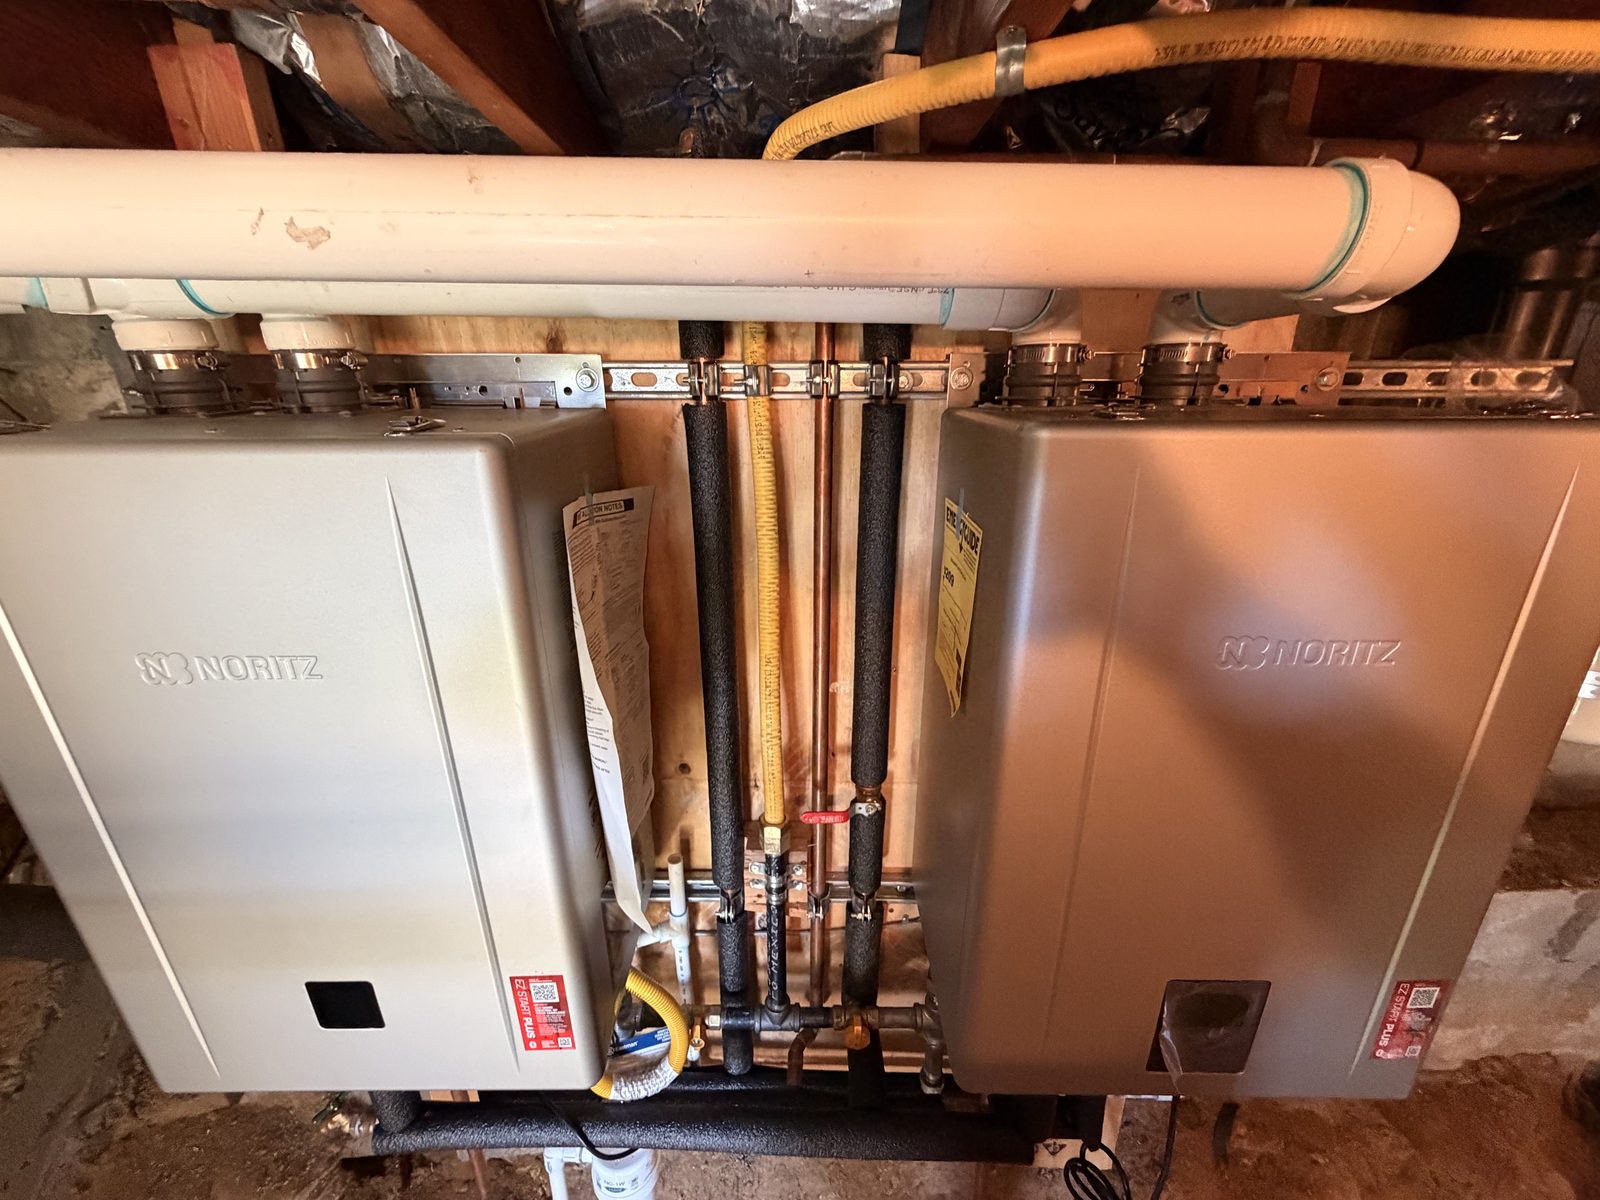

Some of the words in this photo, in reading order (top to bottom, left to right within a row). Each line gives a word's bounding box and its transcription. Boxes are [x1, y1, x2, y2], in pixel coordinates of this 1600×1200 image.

[603, 502, 623, 511] NOTES
[1274, 639, 1401, 666] NORITZ
[195, 655, 324, 681] NORITZ
[514, 978, 527, 990] EZ
[1399, 983, 1410, 996] EZ
[517, 990, 531, 1016] START
[1387, 995, 1406, 1022] START
[522, 1016, 537, 1039] PLUS
[1378, 1023, 1395, 1047] PLUS
